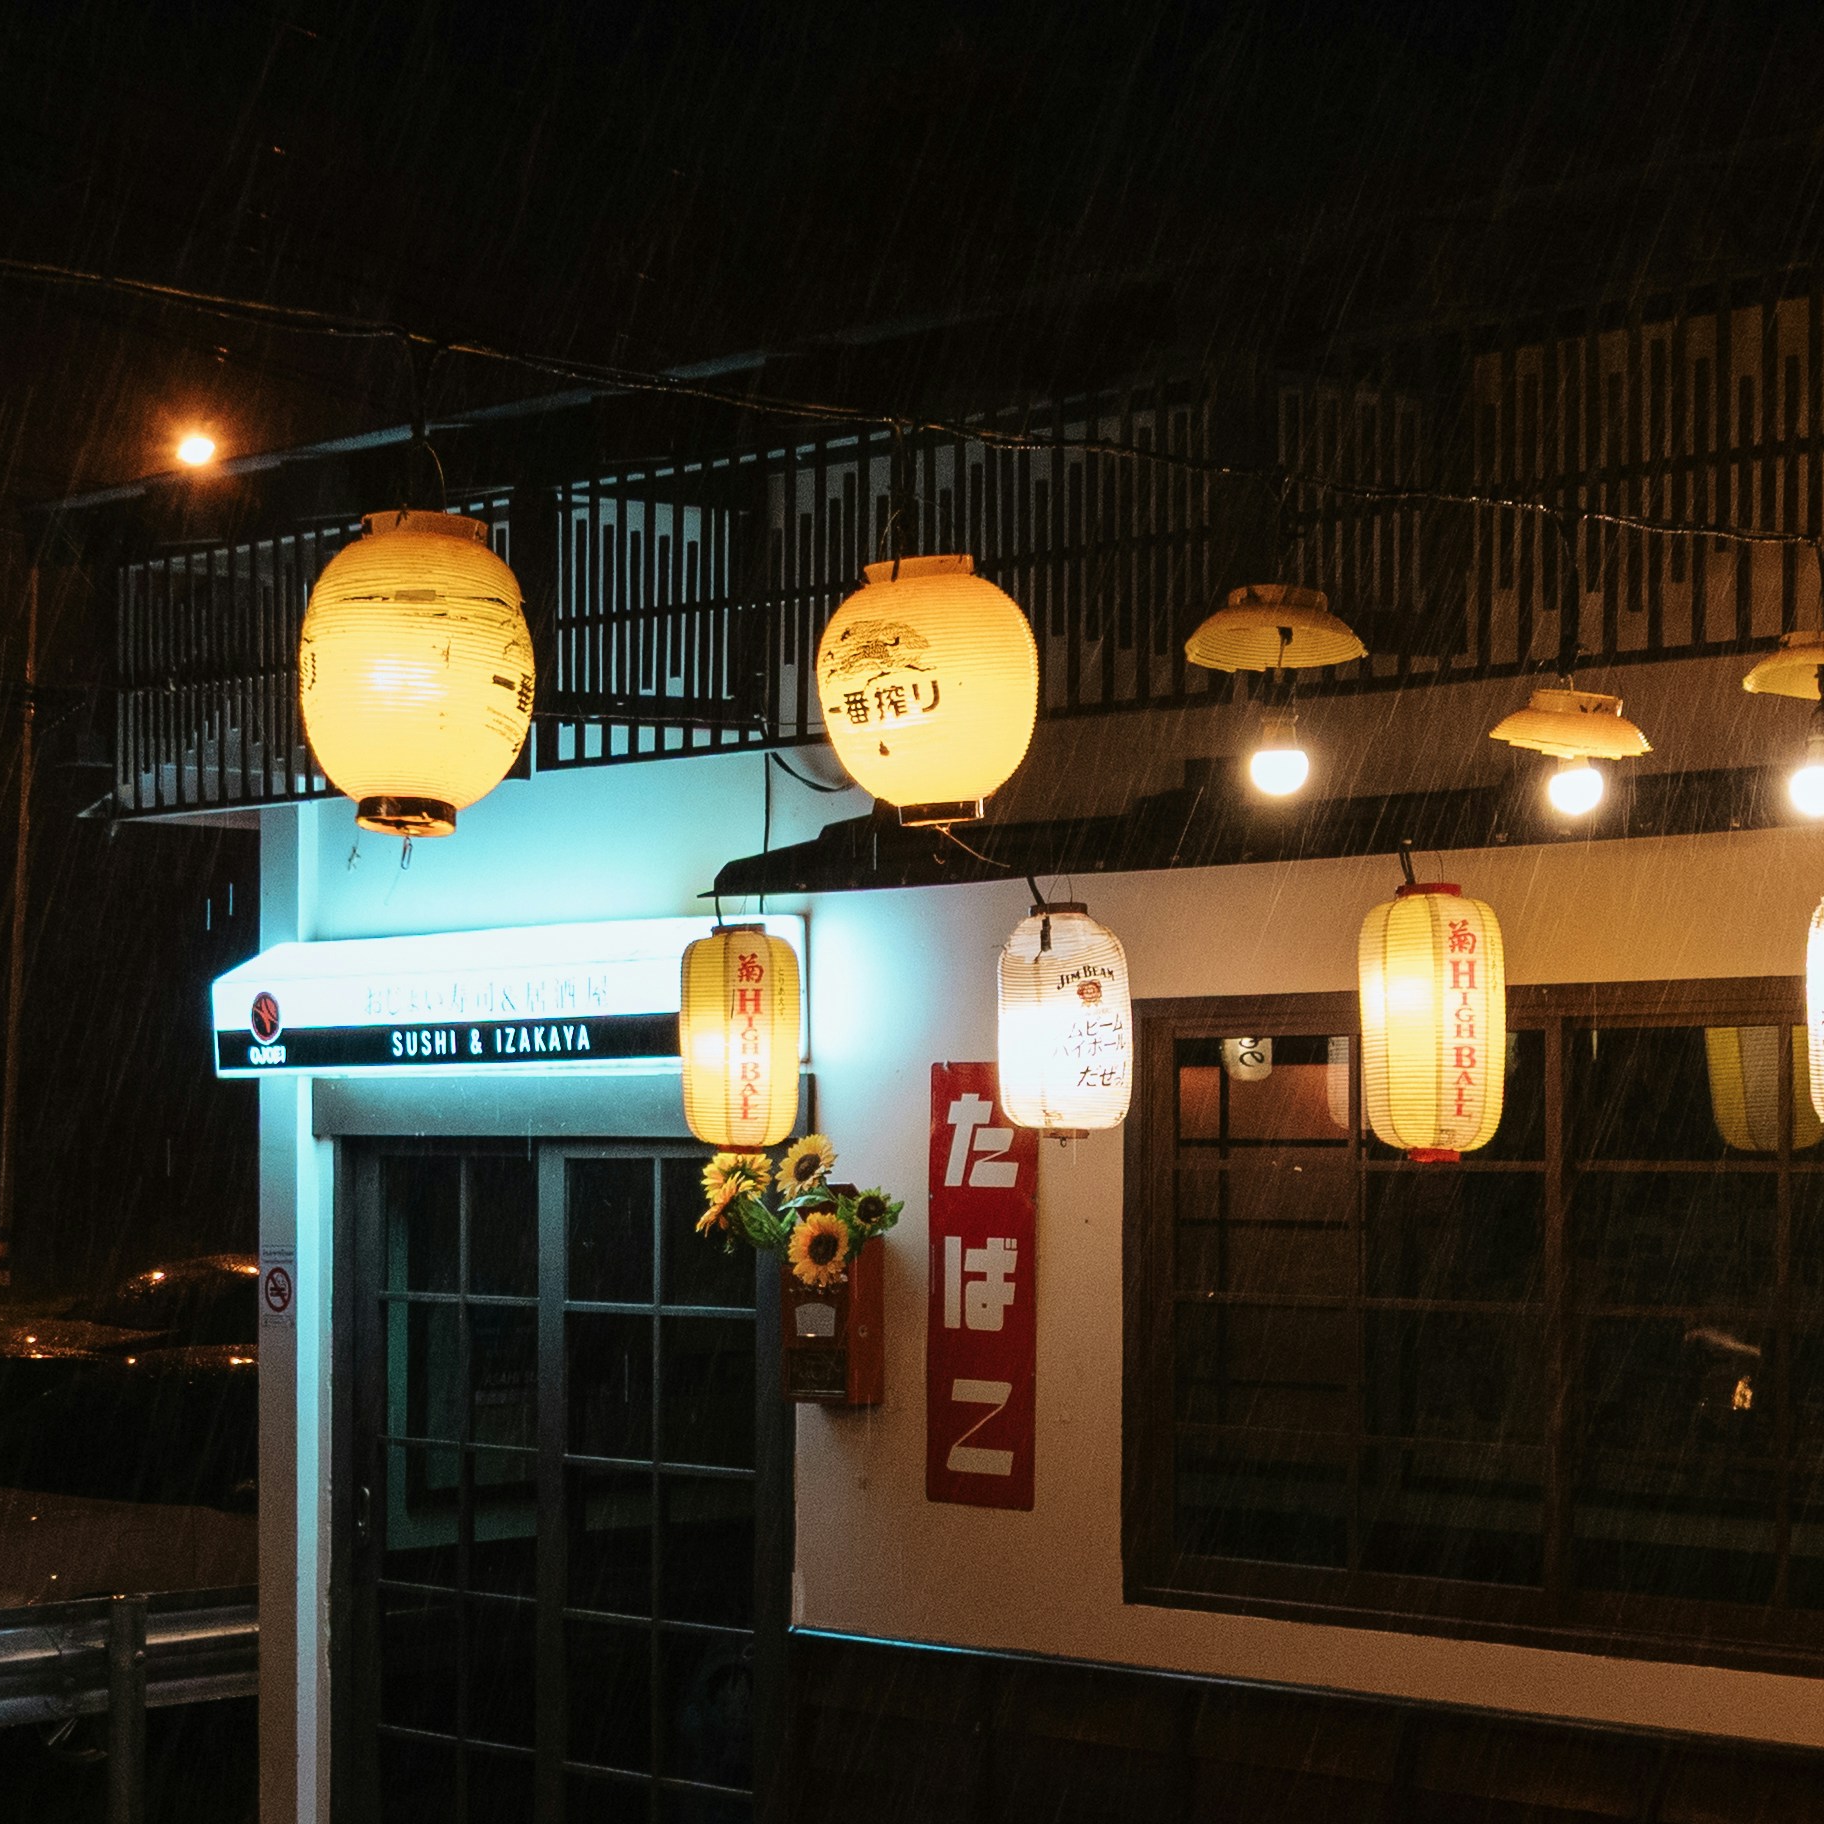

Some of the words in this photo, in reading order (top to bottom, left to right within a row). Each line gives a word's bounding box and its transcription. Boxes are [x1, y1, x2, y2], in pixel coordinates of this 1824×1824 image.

[829, 680, 940, 724] 一番搾り
[392, 1030, 457, 1056] SUSHI
[470, 1031, 481, 1053] &
[496, 1025, 591, 1052] IZAKAYA
[944, 1093, 1019, 1477] たばこ
